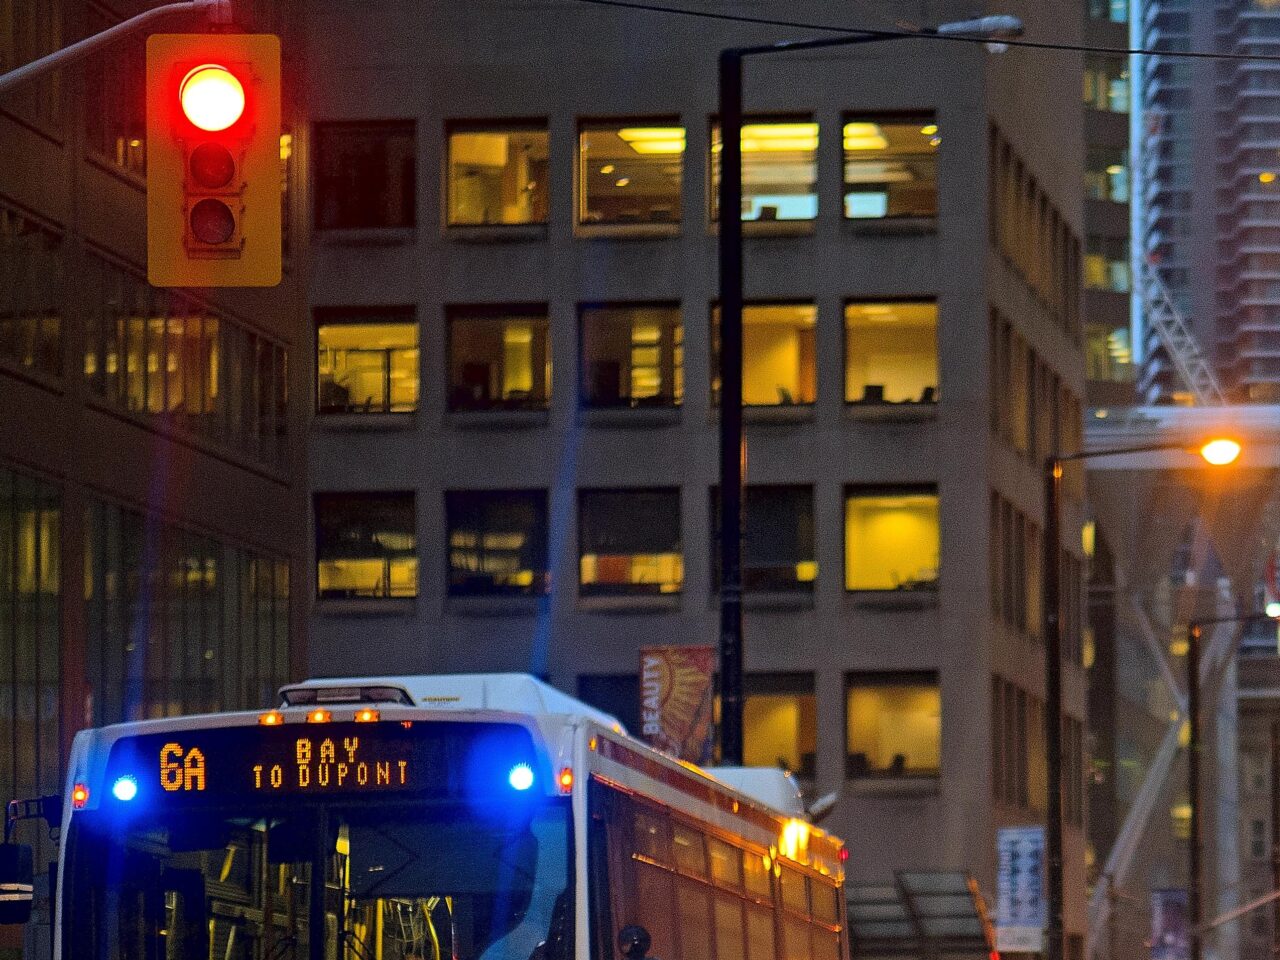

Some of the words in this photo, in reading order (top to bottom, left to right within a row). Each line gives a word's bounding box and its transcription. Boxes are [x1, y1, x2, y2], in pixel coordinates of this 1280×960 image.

[643, 657, 662, 735] BEAUTY
[160, 743, 205, 791] 6A
[297, 737, 358, 763] BAY
[253, 764, 282, 788] TO
[299, 760, 407, 787] DUPONT
